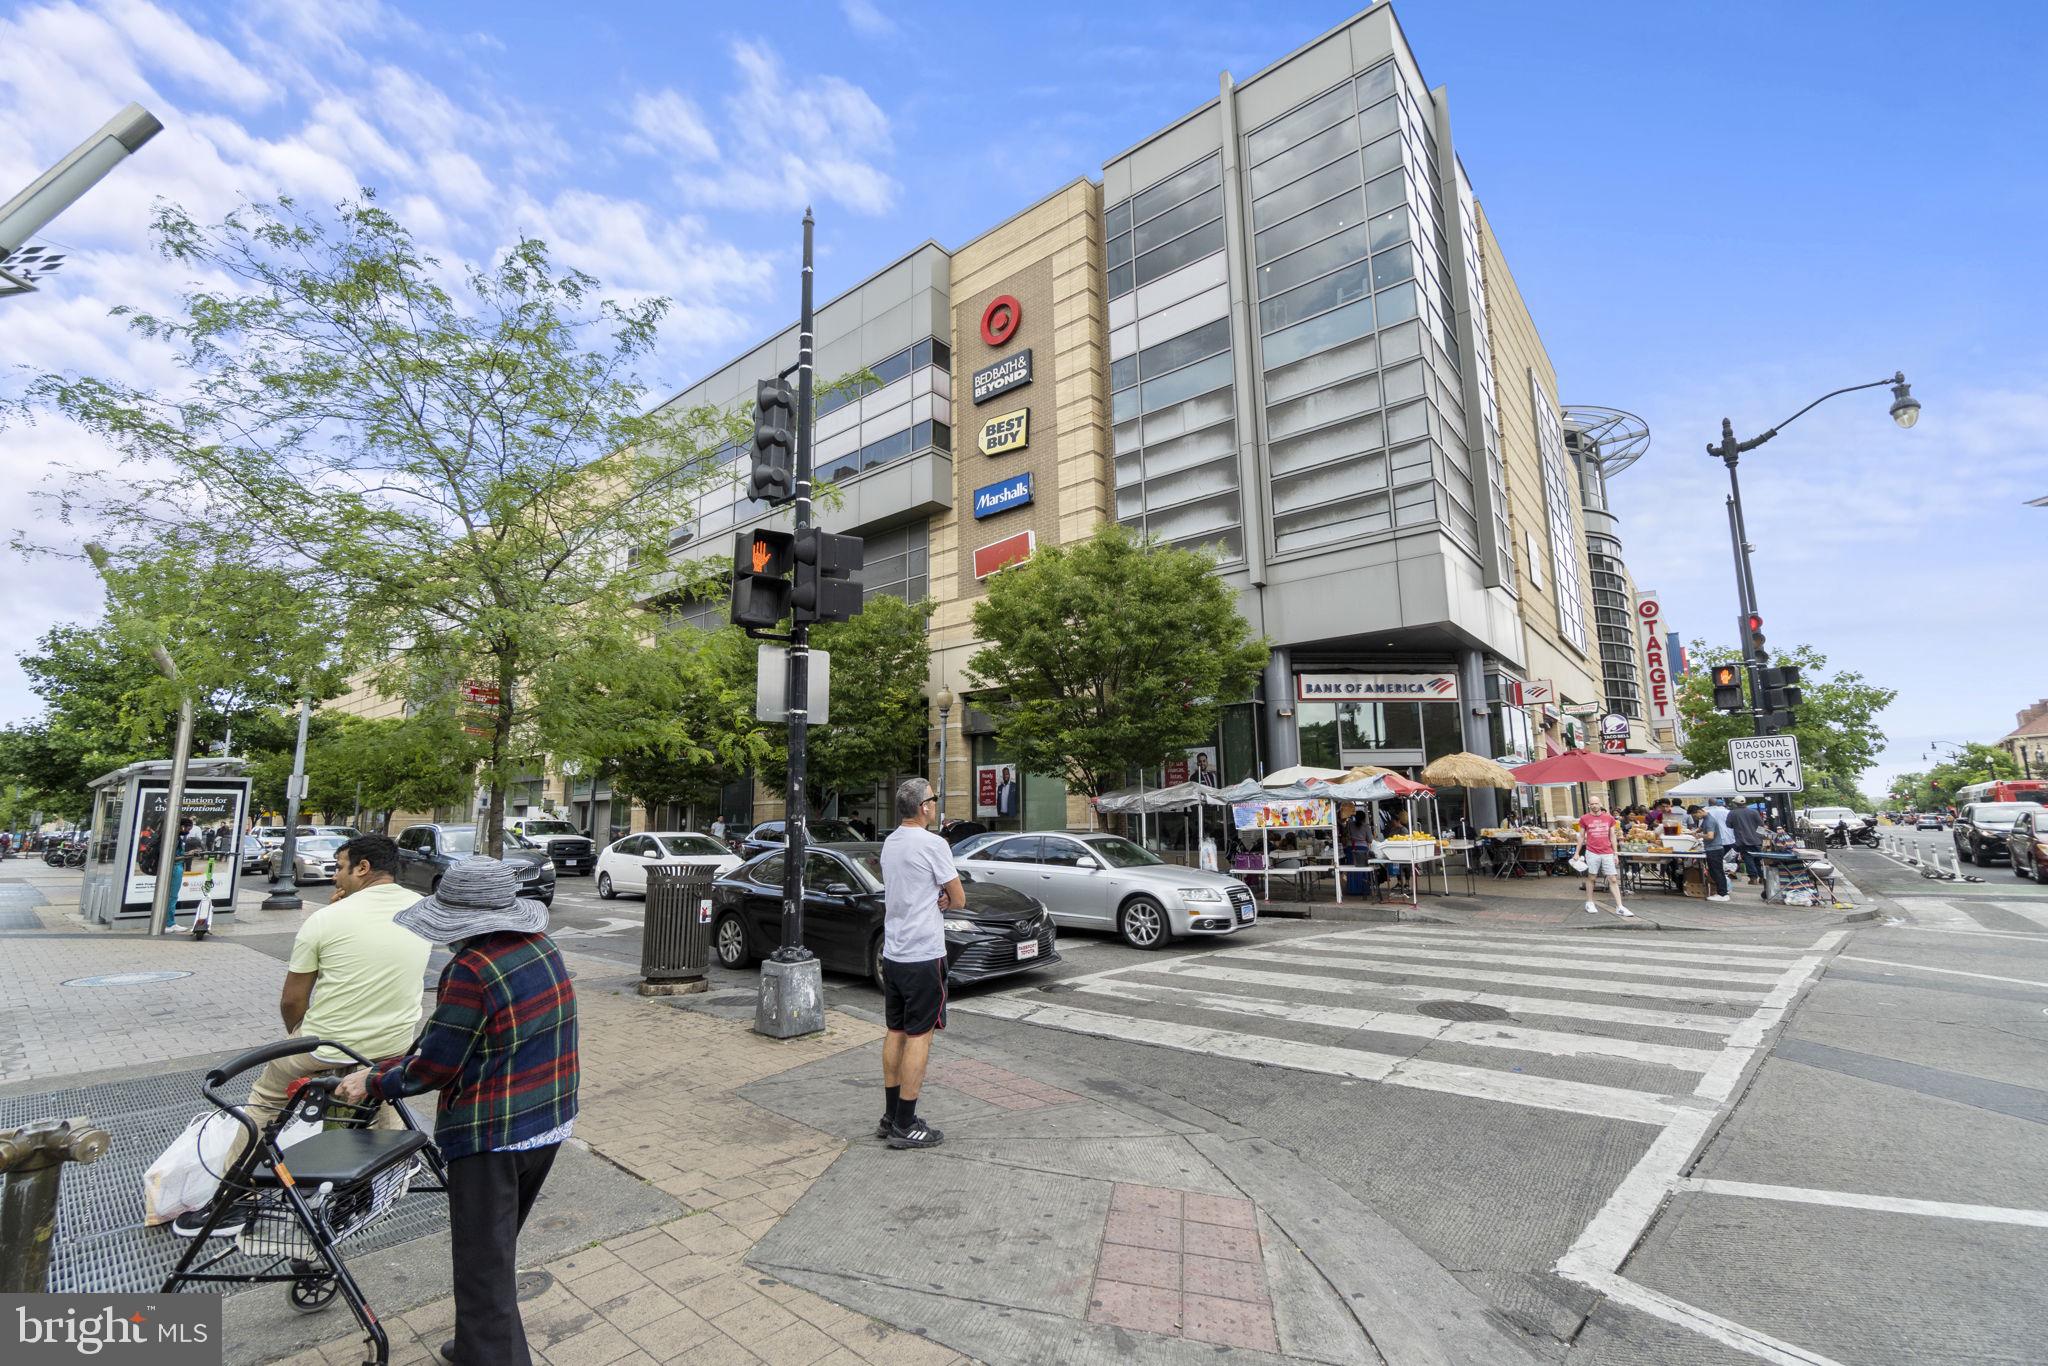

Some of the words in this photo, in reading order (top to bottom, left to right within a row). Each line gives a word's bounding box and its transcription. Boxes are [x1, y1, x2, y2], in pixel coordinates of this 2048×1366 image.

[975, 371, 993, 388] BED
[992, 359, 1018, 380] BATH
[1018, 355, 1027, 368] &
[974, 368, 1028, 398] BEYOND
[985, 415, 1024, 437] BEST
[986, 430, 1020, 450] BUY
[976, 482, 1028, 510] Marshalls
[1643, 619, 1668, 717] TARGET
[1305, 683, 1343, 694] BANK
[1344, 683, 1363, 694] OF
[1364, 683, 1426, 693] AMERICA
[1735, 739, 1789, 750] DIAGONAL
[1736, 749, 1791, 759] CROSSING
[1737, 768, 1759, 786] OK
[154, 796, 163, 804] A
[214, 796, 228, 804] for
